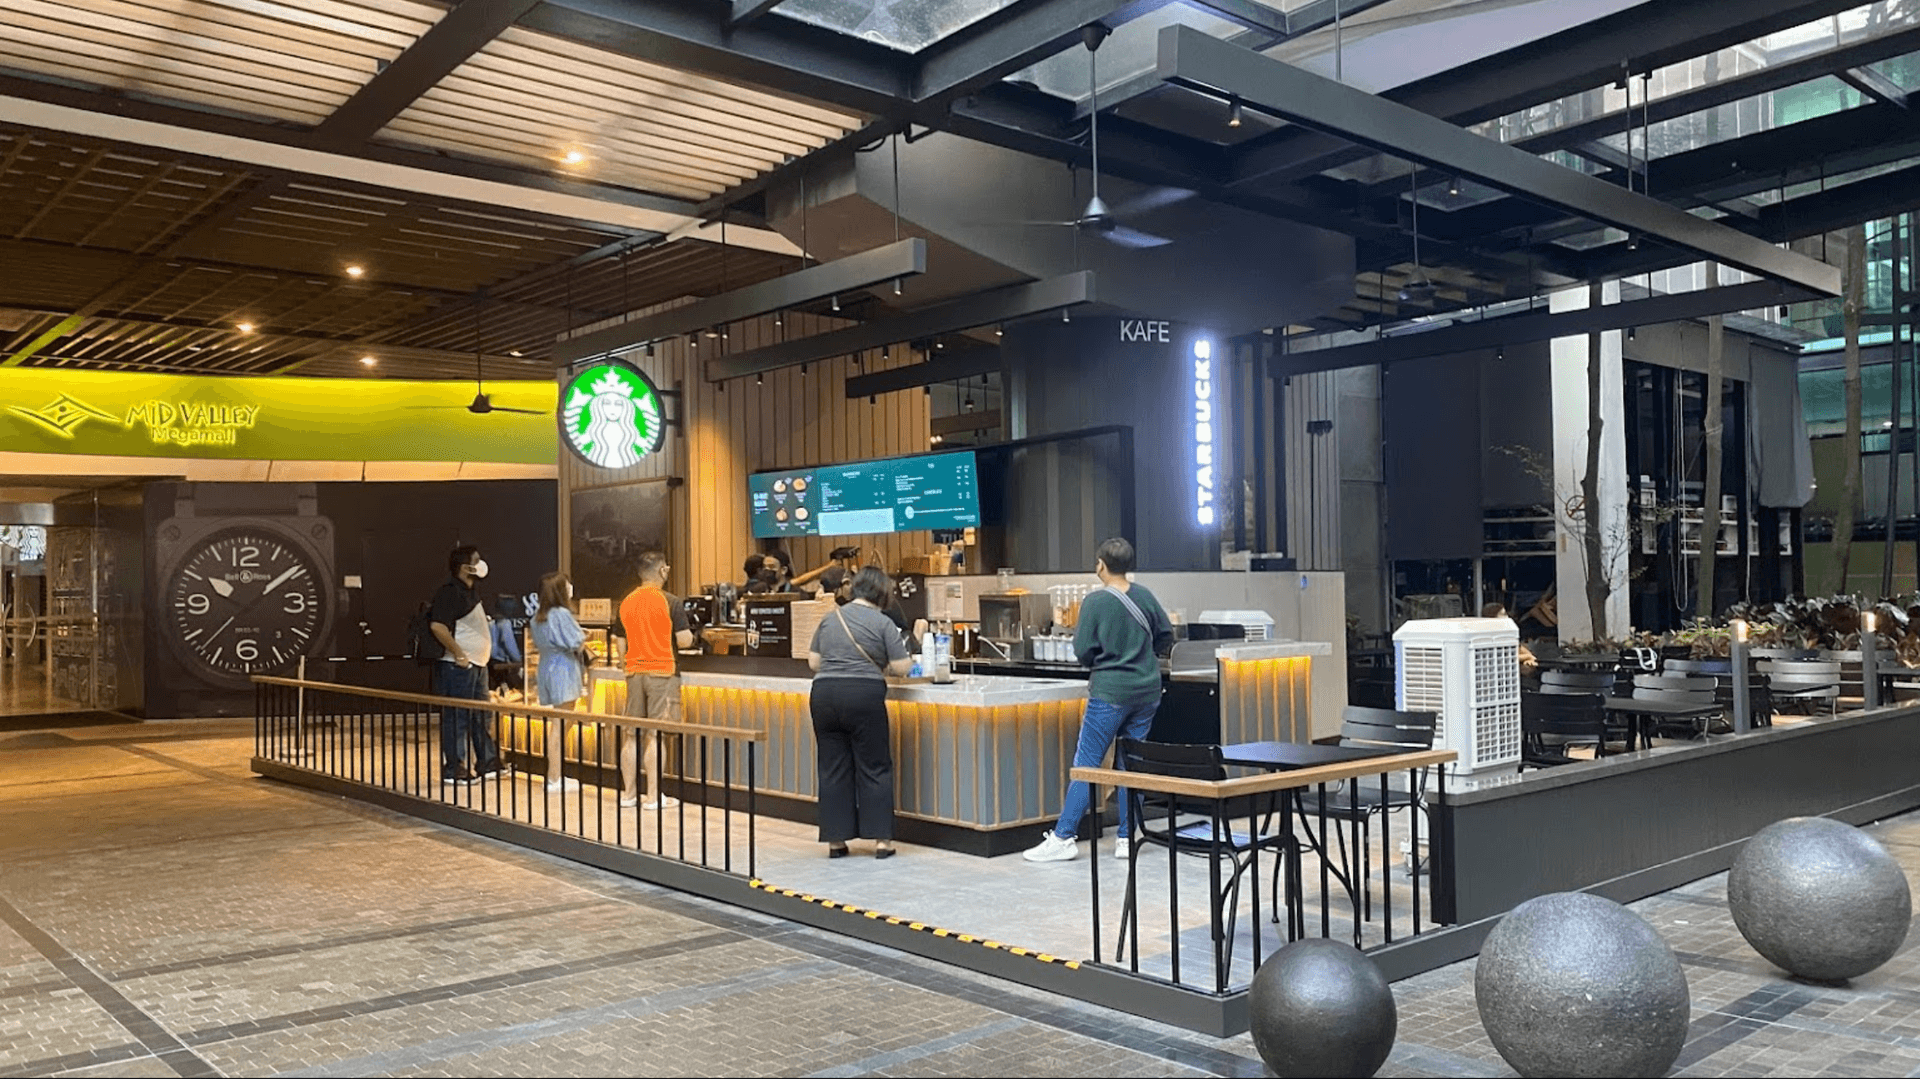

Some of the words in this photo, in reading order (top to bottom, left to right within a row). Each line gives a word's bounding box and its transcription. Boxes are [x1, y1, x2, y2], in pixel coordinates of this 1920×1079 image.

[1120, 319, 1170, 342] KAFE
[180, 402, 259, 427] VALLEY
[152, 427, 236, 445] Megamall
[1194, 339, 1213, 525] STARBUCKS
[231, 546, 260, 567] 12
[187, 593, 210, 615] 9
[283, 592, 305, 614] 3
[236, 639, 259, 660] 6
